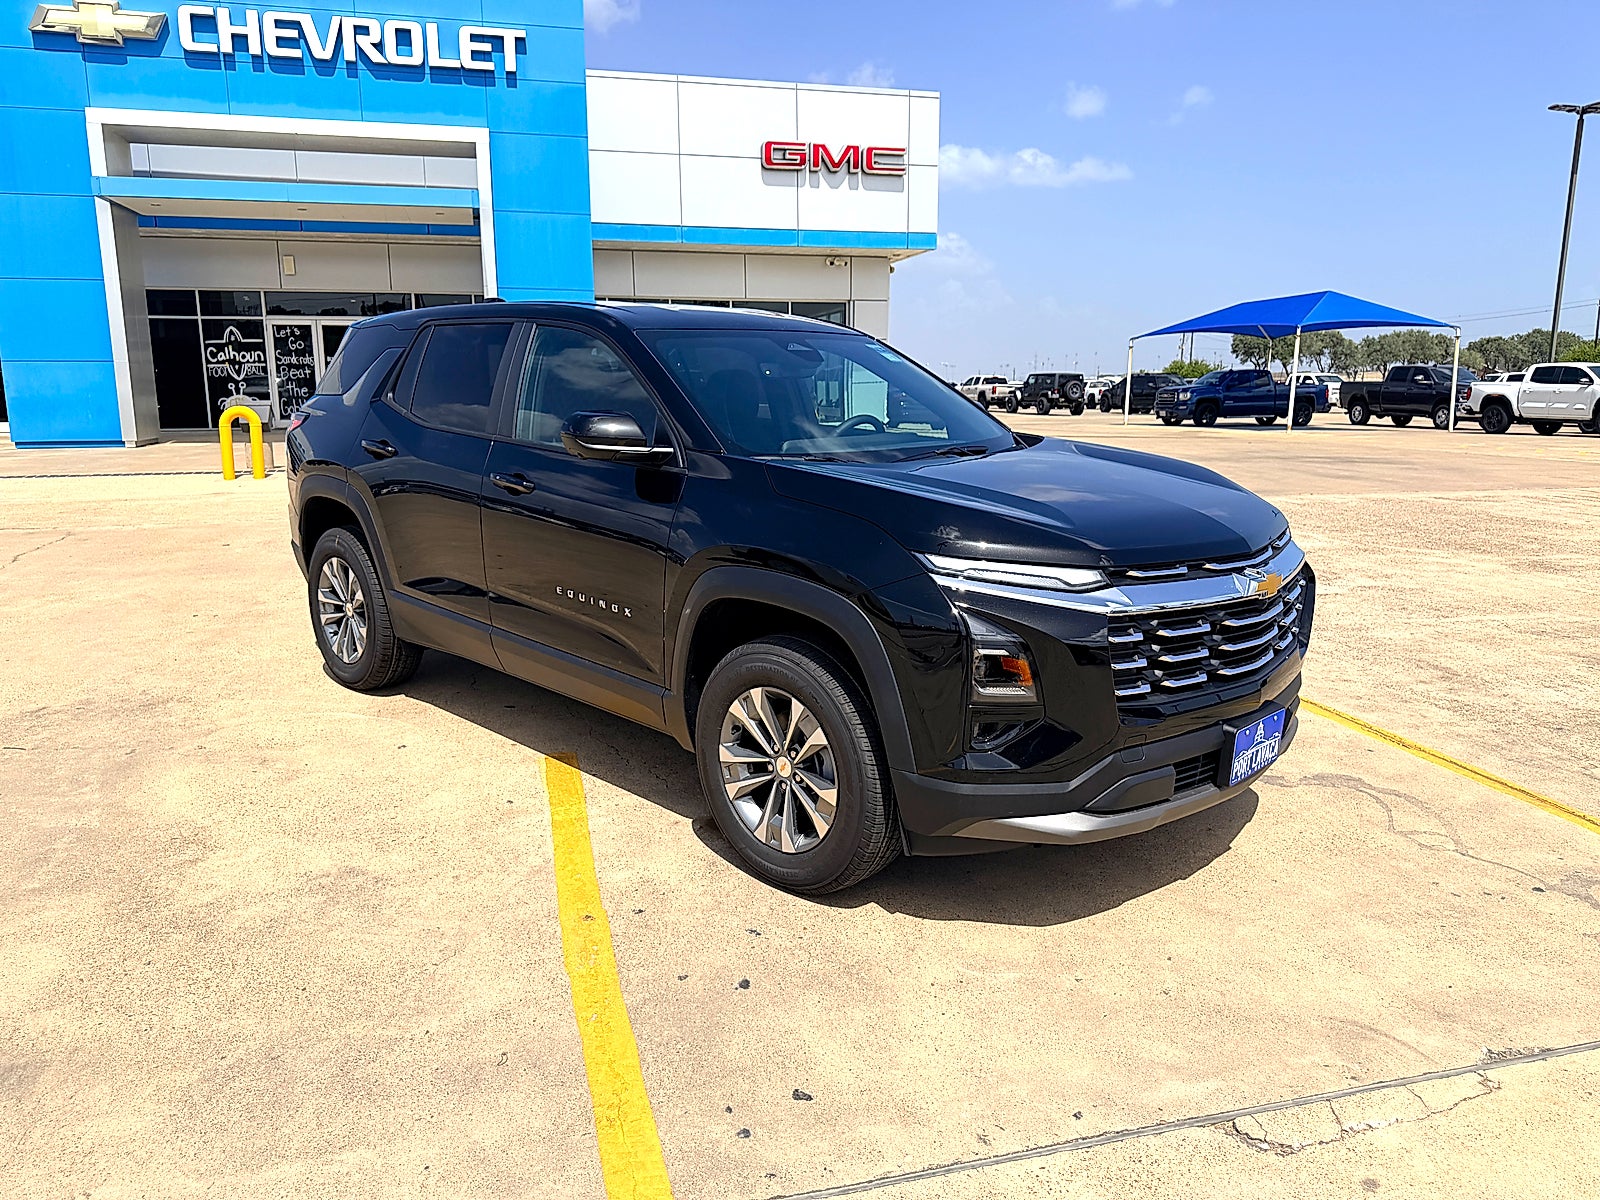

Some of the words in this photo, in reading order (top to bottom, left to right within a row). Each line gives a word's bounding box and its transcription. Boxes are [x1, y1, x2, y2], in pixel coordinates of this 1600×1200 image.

[177, 5, 527, 73] CHEVROLET
[761, 140, 907, 176] GMC
[274, 326, 300, 337] Let's
[288, 337, 304, 350] Go
[207, 345, 264, 362] Calhoun
[280, 366, 311, 380] Beat
[286, 381, 308, 397] the
[556, 586, 632, 617] EQUINOX
[1232, 753, 1252, 779] PORT
[1252, 739, 1278, 768] LAVACA
